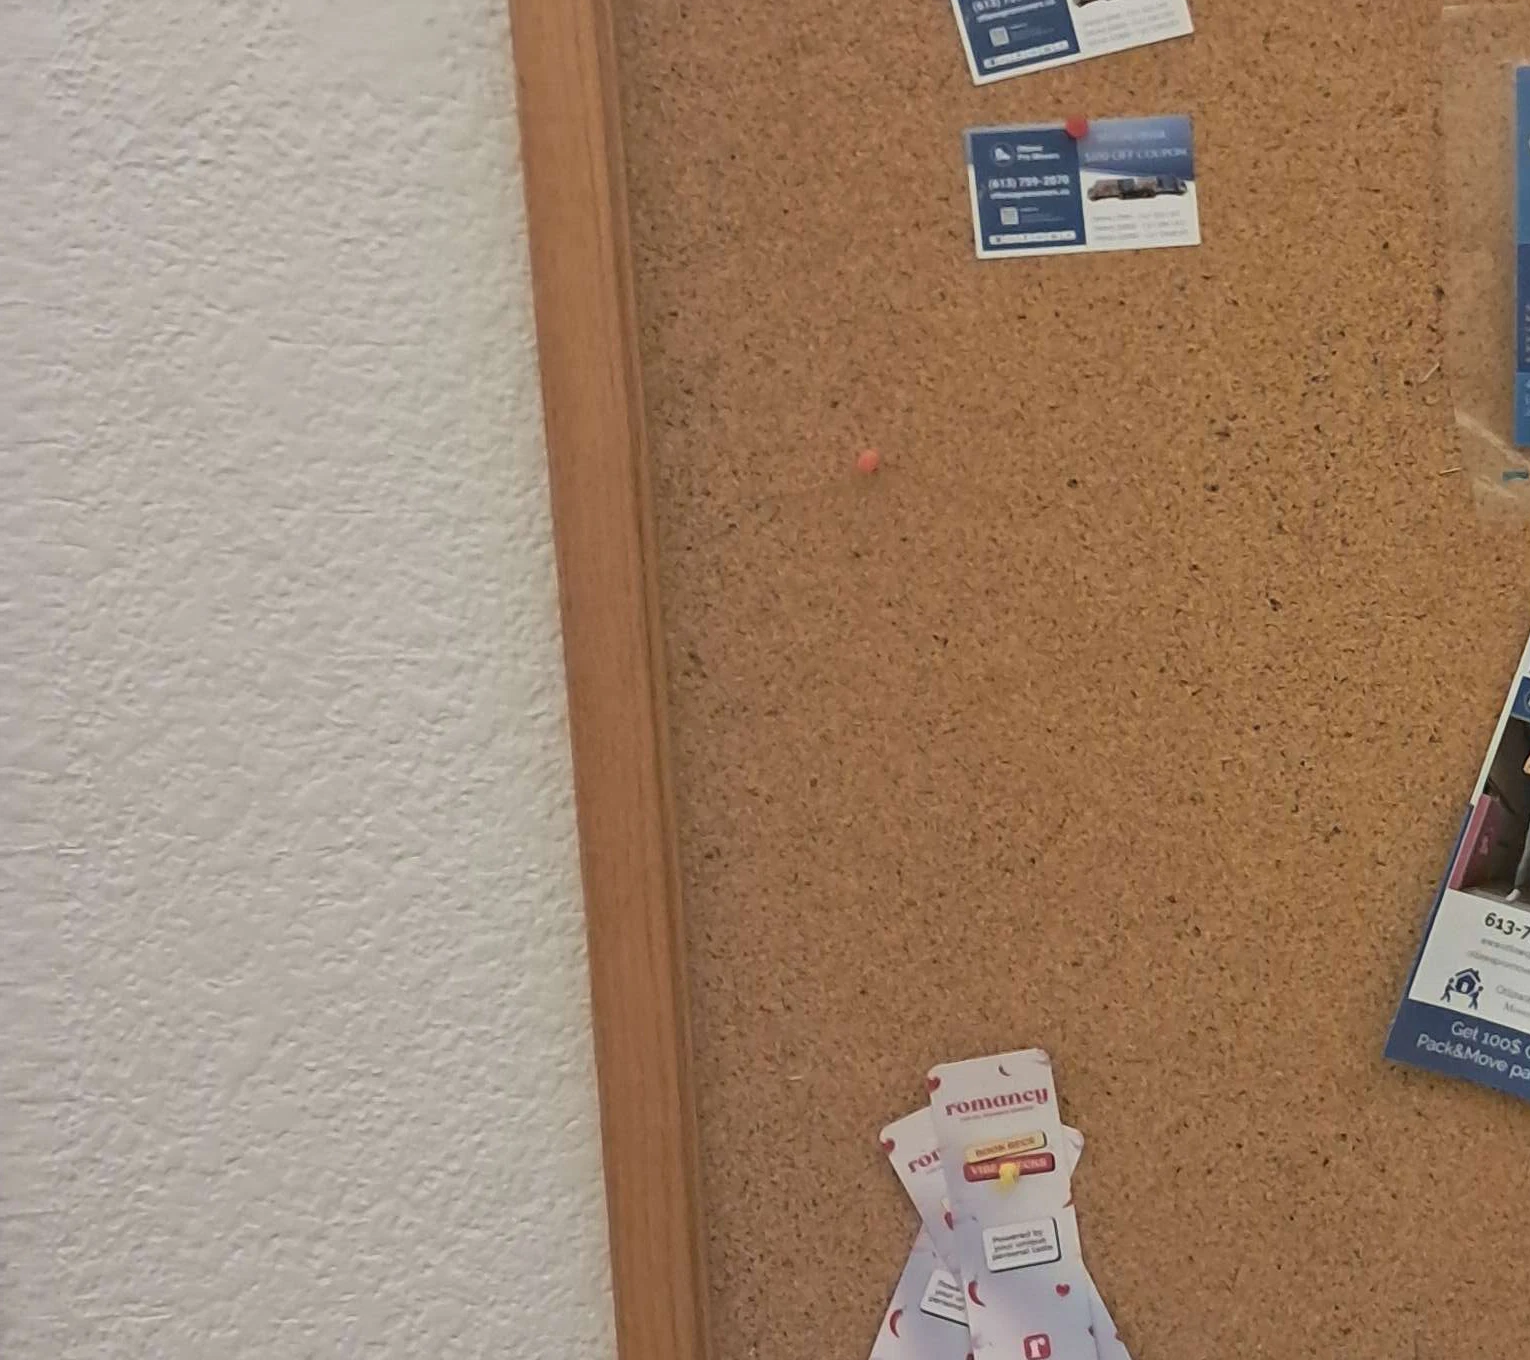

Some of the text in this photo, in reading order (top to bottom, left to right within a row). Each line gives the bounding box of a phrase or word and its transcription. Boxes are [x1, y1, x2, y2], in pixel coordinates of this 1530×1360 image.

[1417, 1033, 1509, 1072] Pack&Move
[1451, 1021, 1478, 1041] Get
[1483, 1031, 1521, 1056] 100$
[945, 1088, 1048, 1116] romancy
